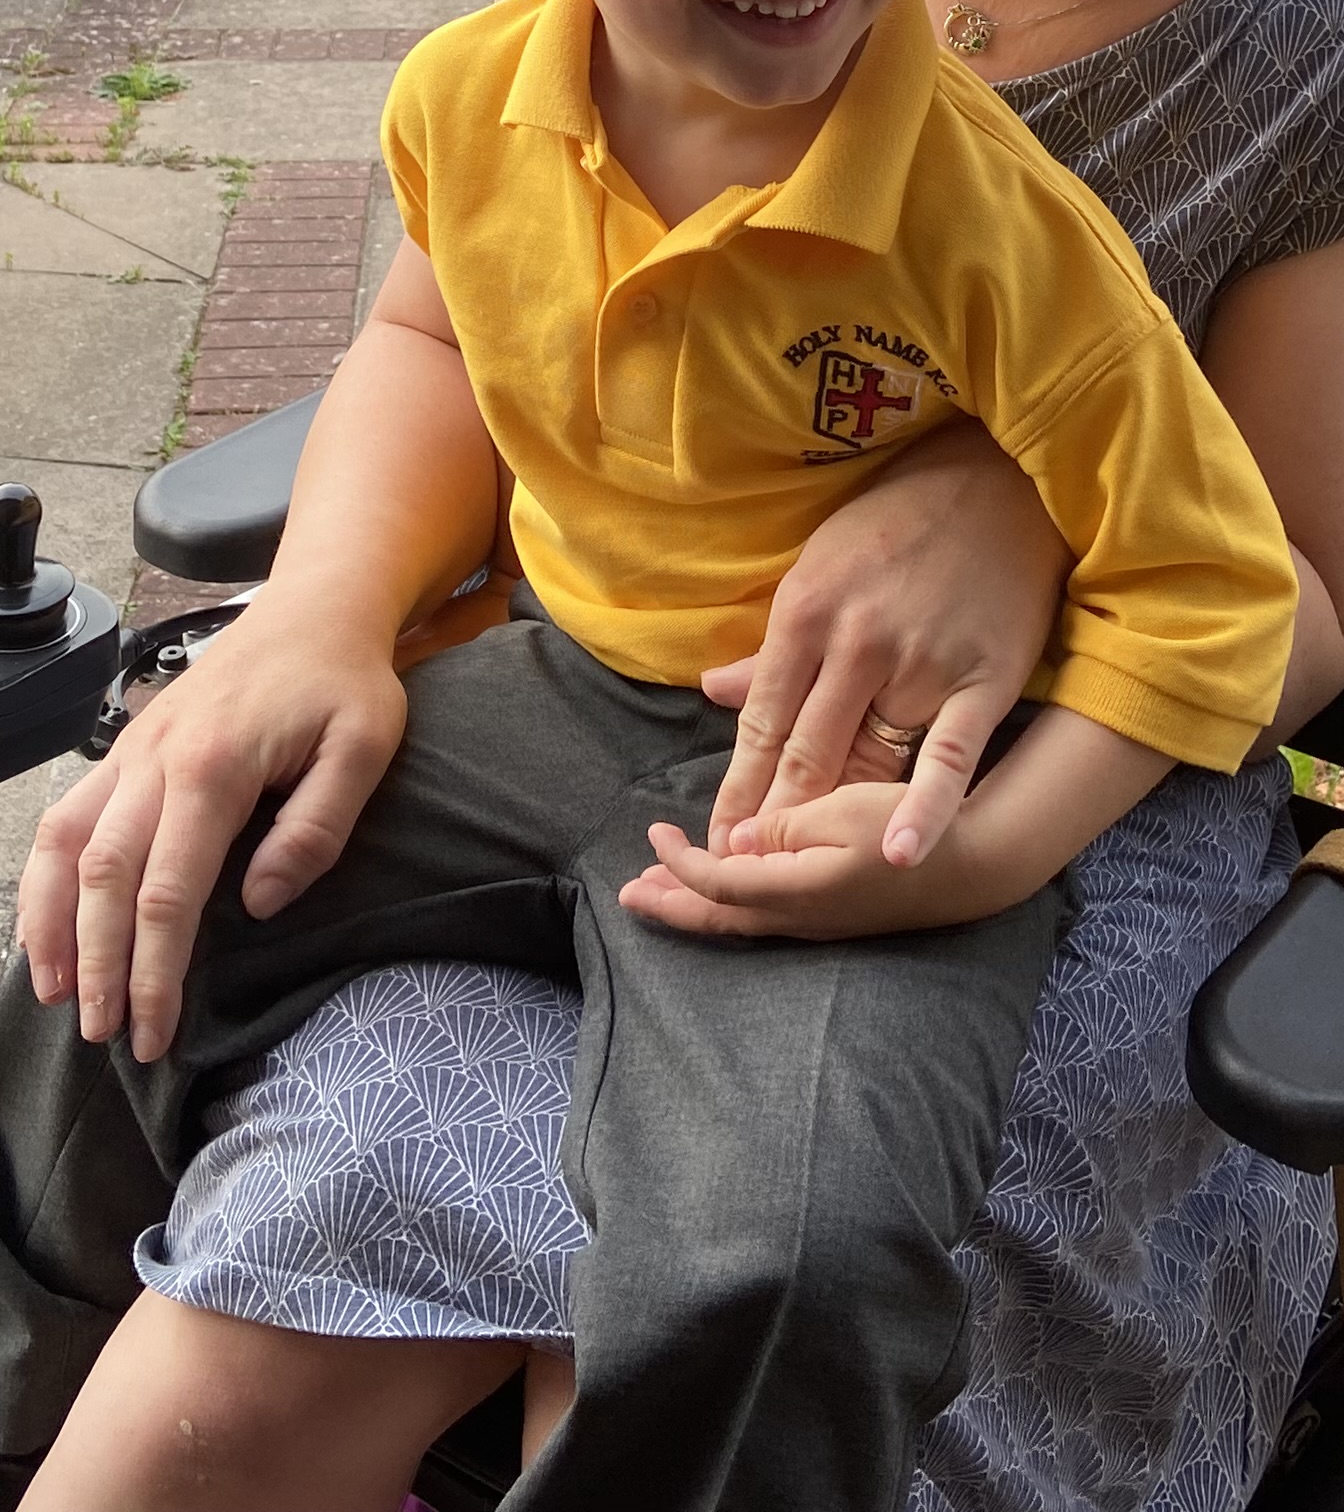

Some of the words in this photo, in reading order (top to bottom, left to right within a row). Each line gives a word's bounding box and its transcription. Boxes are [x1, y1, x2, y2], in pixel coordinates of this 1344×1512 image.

[782, 324, 842, 368] HOLY
[854, 324, 930, 368] NAME
[831, 360, 856, 387] H
[826, 409, 849, 432] P
